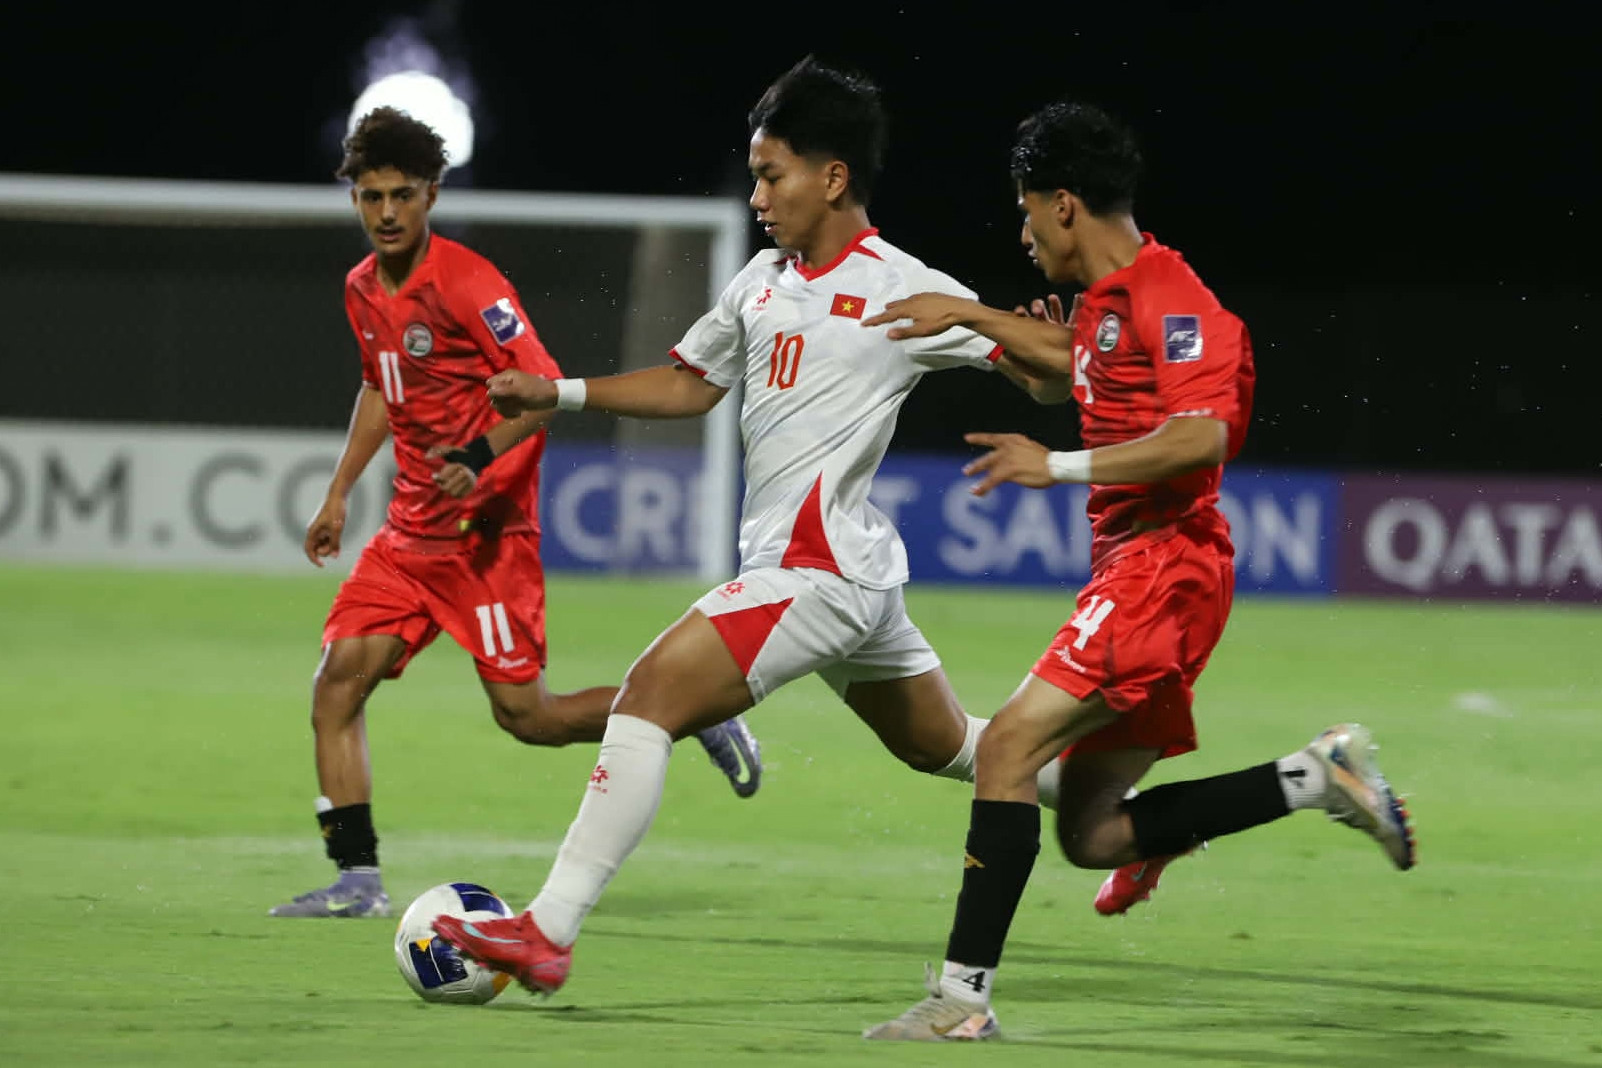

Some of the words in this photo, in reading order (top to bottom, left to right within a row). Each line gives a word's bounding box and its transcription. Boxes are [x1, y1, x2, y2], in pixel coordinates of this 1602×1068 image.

[378, 351, 405, 404] 11
[767, 331, 805, 390] 10
[475, 602, 515, 657] 11
[1071, 594, 1116, 651] 4
[962, 970, 986, 993] 4
